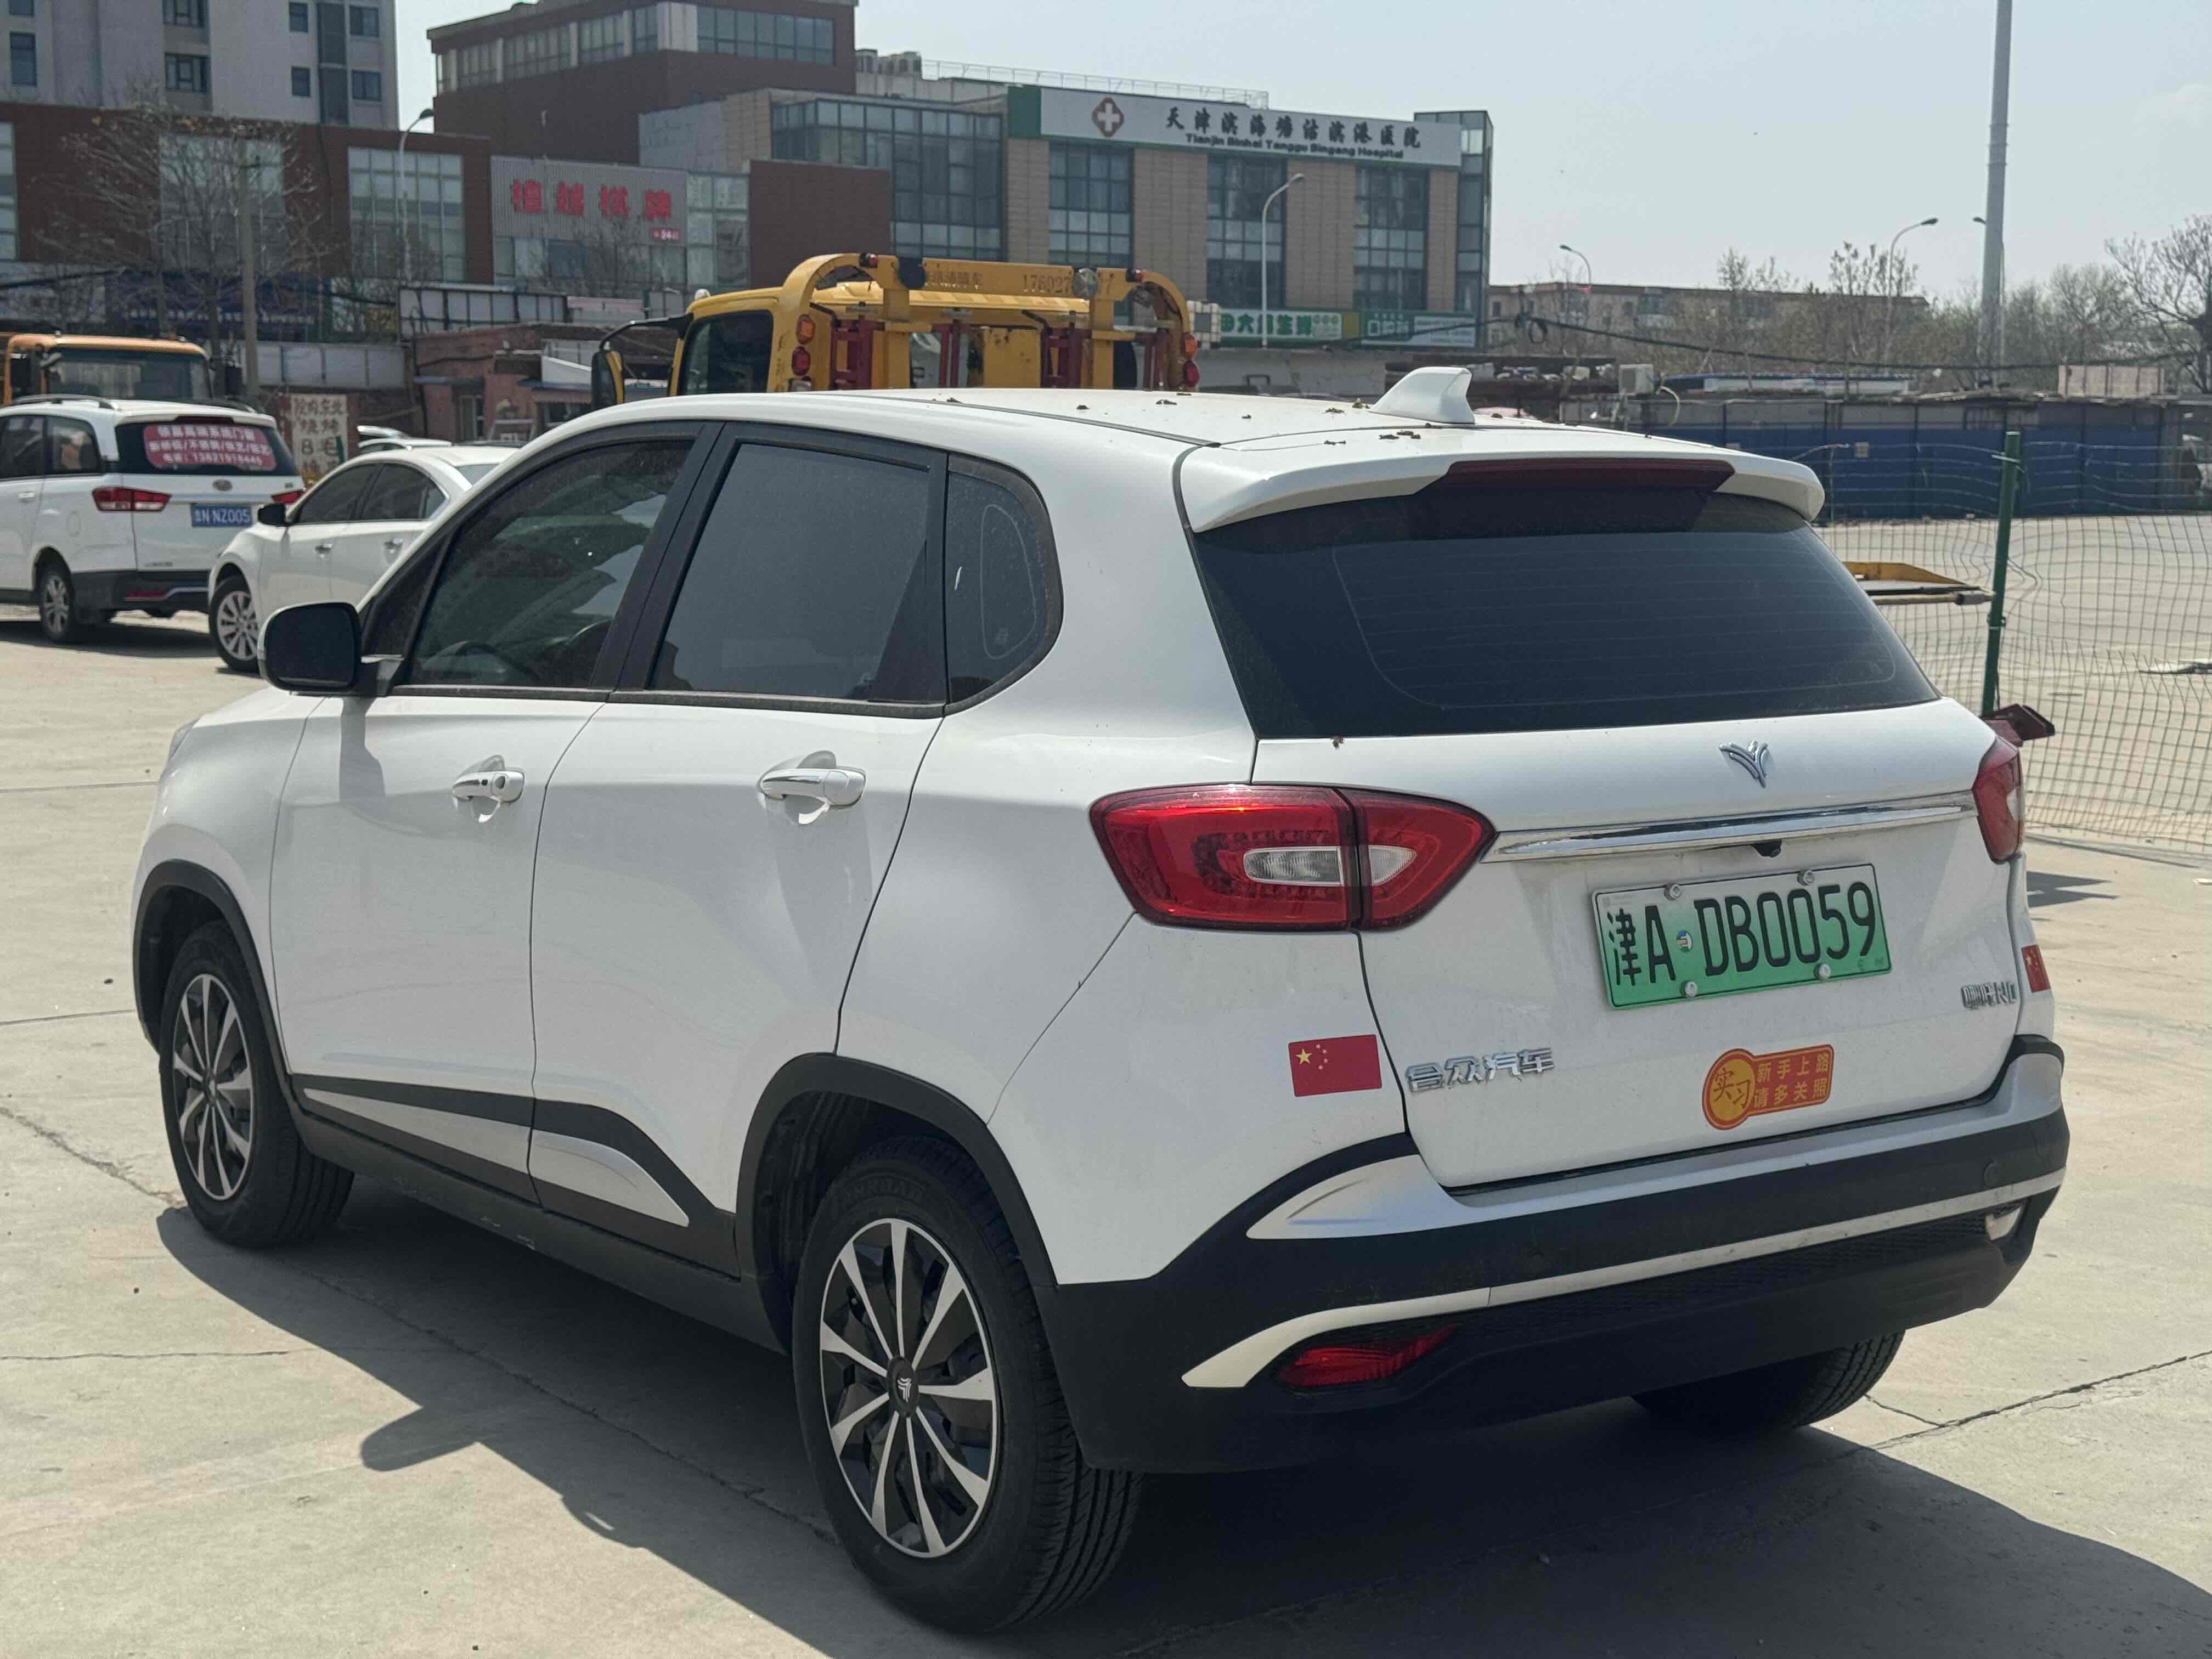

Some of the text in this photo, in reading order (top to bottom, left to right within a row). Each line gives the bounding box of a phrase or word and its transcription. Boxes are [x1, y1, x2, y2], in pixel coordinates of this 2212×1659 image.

[1186, 133, 1224, 146] Tianjin
[1227, 137, 1262, 148] Binhai
[1265, 140, 1308, 153] Tanggu
[1358, 147, 1404, 159] Hospital
[1405, 1047, 1555, 1092] 合众汽车
[1757, 1052, 1830, 1083] 新手上路
[1710, 1067, 1751, 1109] 实习
[1754, 1077, 1827, 1107] 请多关照
